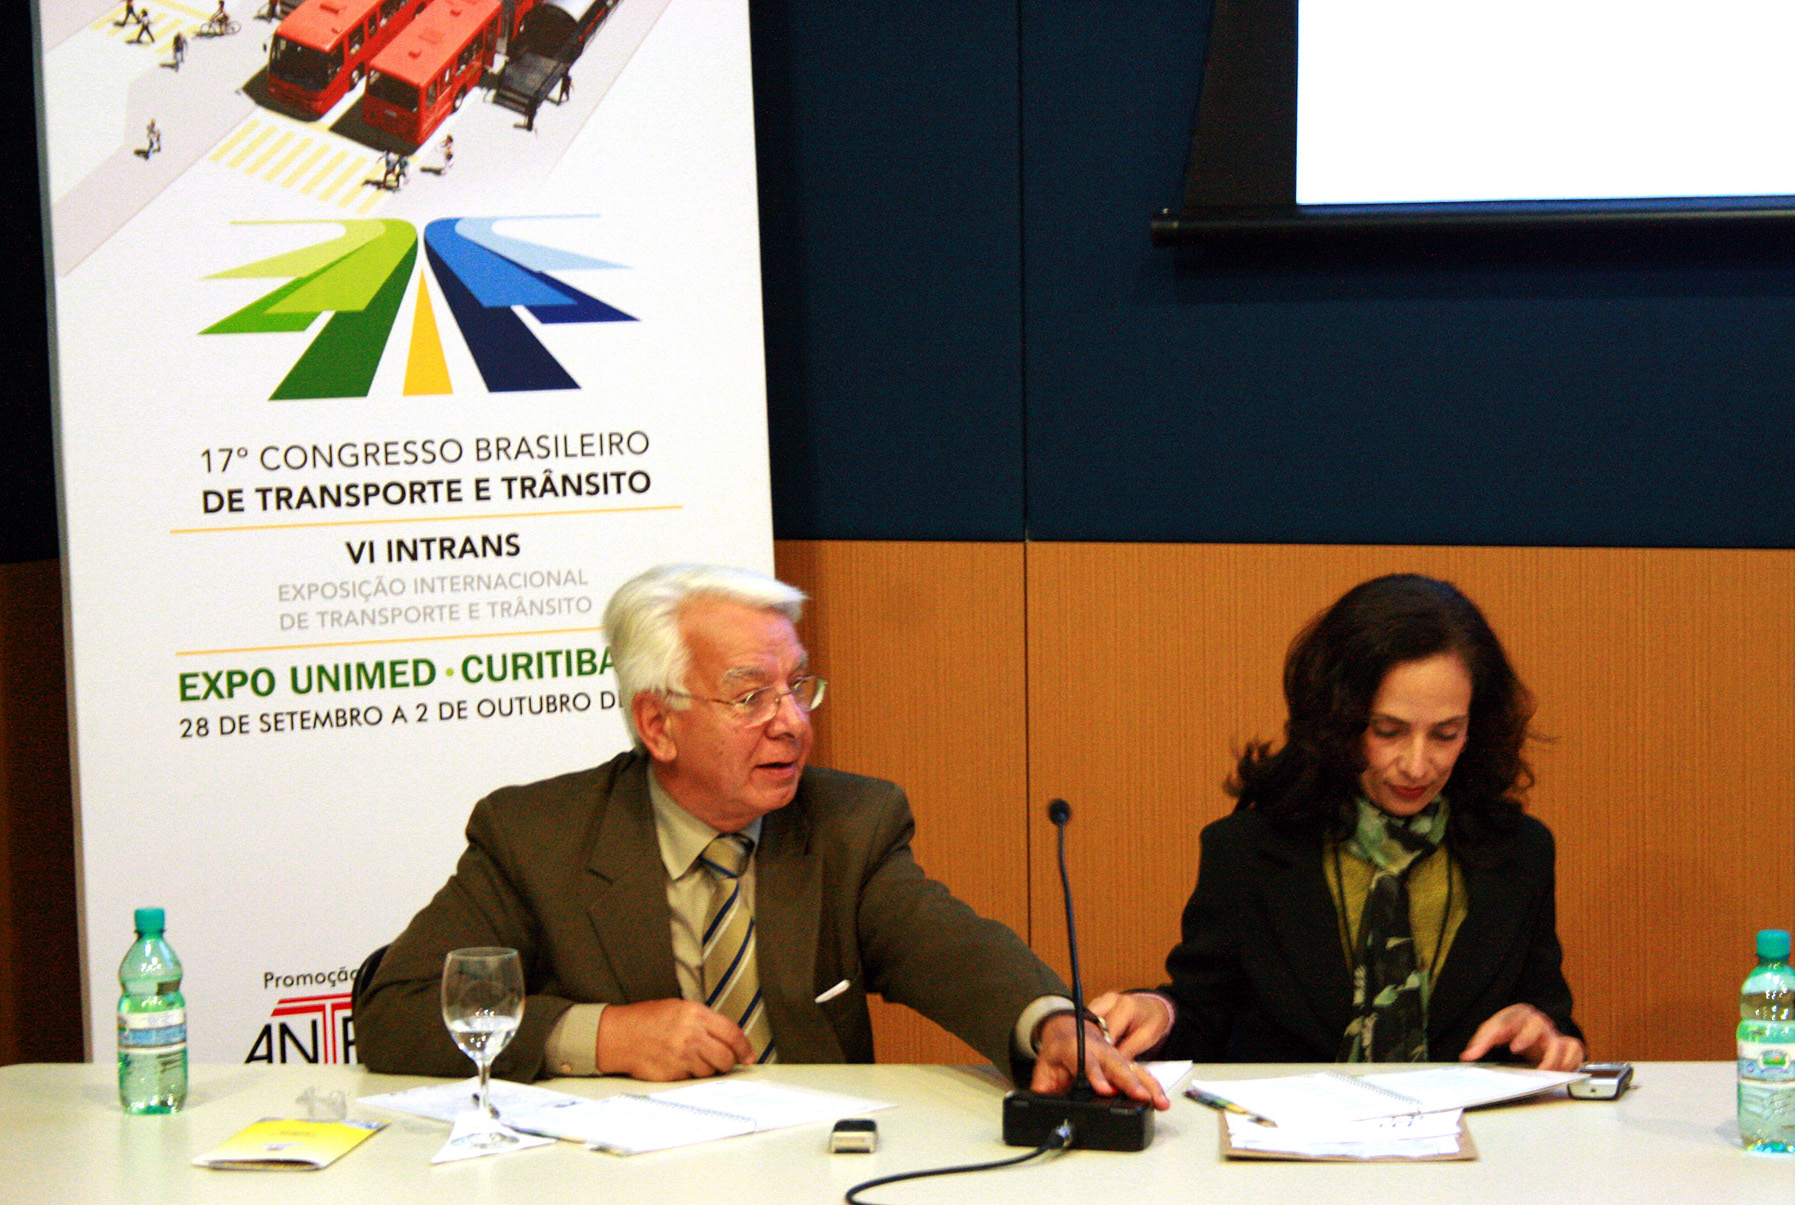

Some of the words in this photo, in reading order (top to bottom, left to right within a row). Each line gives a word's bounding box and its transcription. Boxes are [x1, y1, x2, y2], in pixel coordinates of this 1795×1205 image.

[259, 438, 464, 472] CONGRESSO
[475, 430, 650, 463] BRASILEIRO
[202, 488, 245, 515] DE
[254, 478, 463, 512] TRANSPORTE
[474, 477, 492, 502] E
[500, 469, 652, 500] TRÂNSITO
[345, 540, 375, 565] VI
[386, 532, 521, 563] INTRANS
[277, 574, 404, 603] EXPOSIÇÃO
[413, 568, 589, 595] INTERNACIONAL
[279, 613, 307, 631] DE
[316, 604, 460, 629] TRANSPORTE
[468, 603, 480, 619] E
[488, 594, 593, 619] TRÂNSITO
[178, 667, 276, 702] EXPO
[289, 658, 437, 695] UNIMED
[461, 645, 616, 685] CURITIBA
[179, 716, 210, 739] 28
[219, 714, 250, 736] DE
[259, 706, 384, 734] SETEMBRO
[391, 705, 408, 724] A
[415, 702, 428, 723] 2
[438, 700, 468, 721] DE
[476, 692, 592, 719] OUTUBRO
